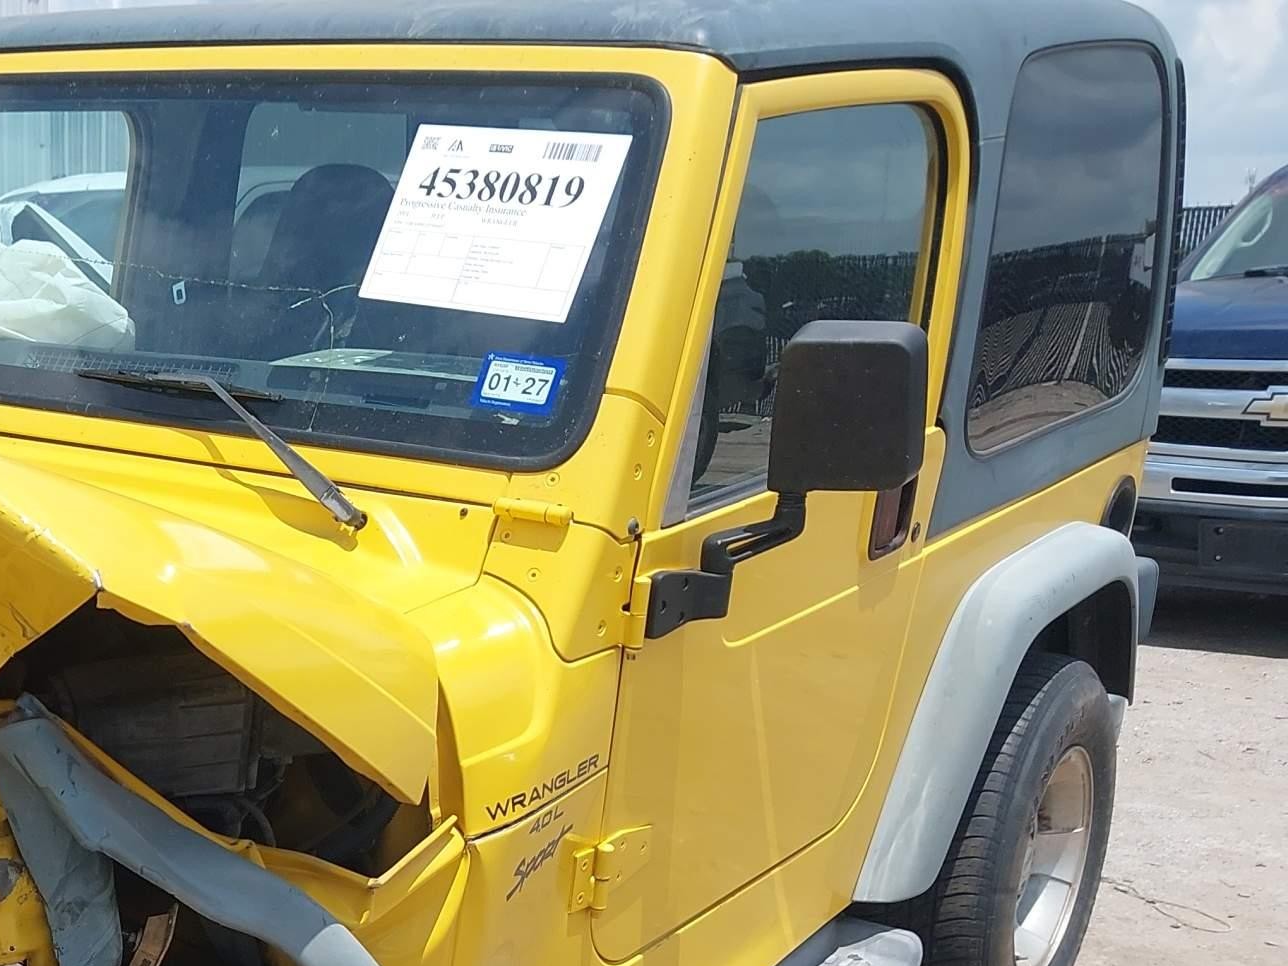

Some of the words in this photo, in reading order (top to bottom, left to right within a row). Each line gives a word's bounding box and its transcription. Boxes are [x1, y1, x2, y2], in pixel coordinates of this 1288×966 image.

[399, 197, 447, 211] Progressive
[447, 202, 483, 214] Casualty
[485, 204, 527, 217] Insurance
[418, 166, 585, 208] 45380819
[485, 753, 600, 822] WRANGLER
[505, 823, 574, 902] Sport
